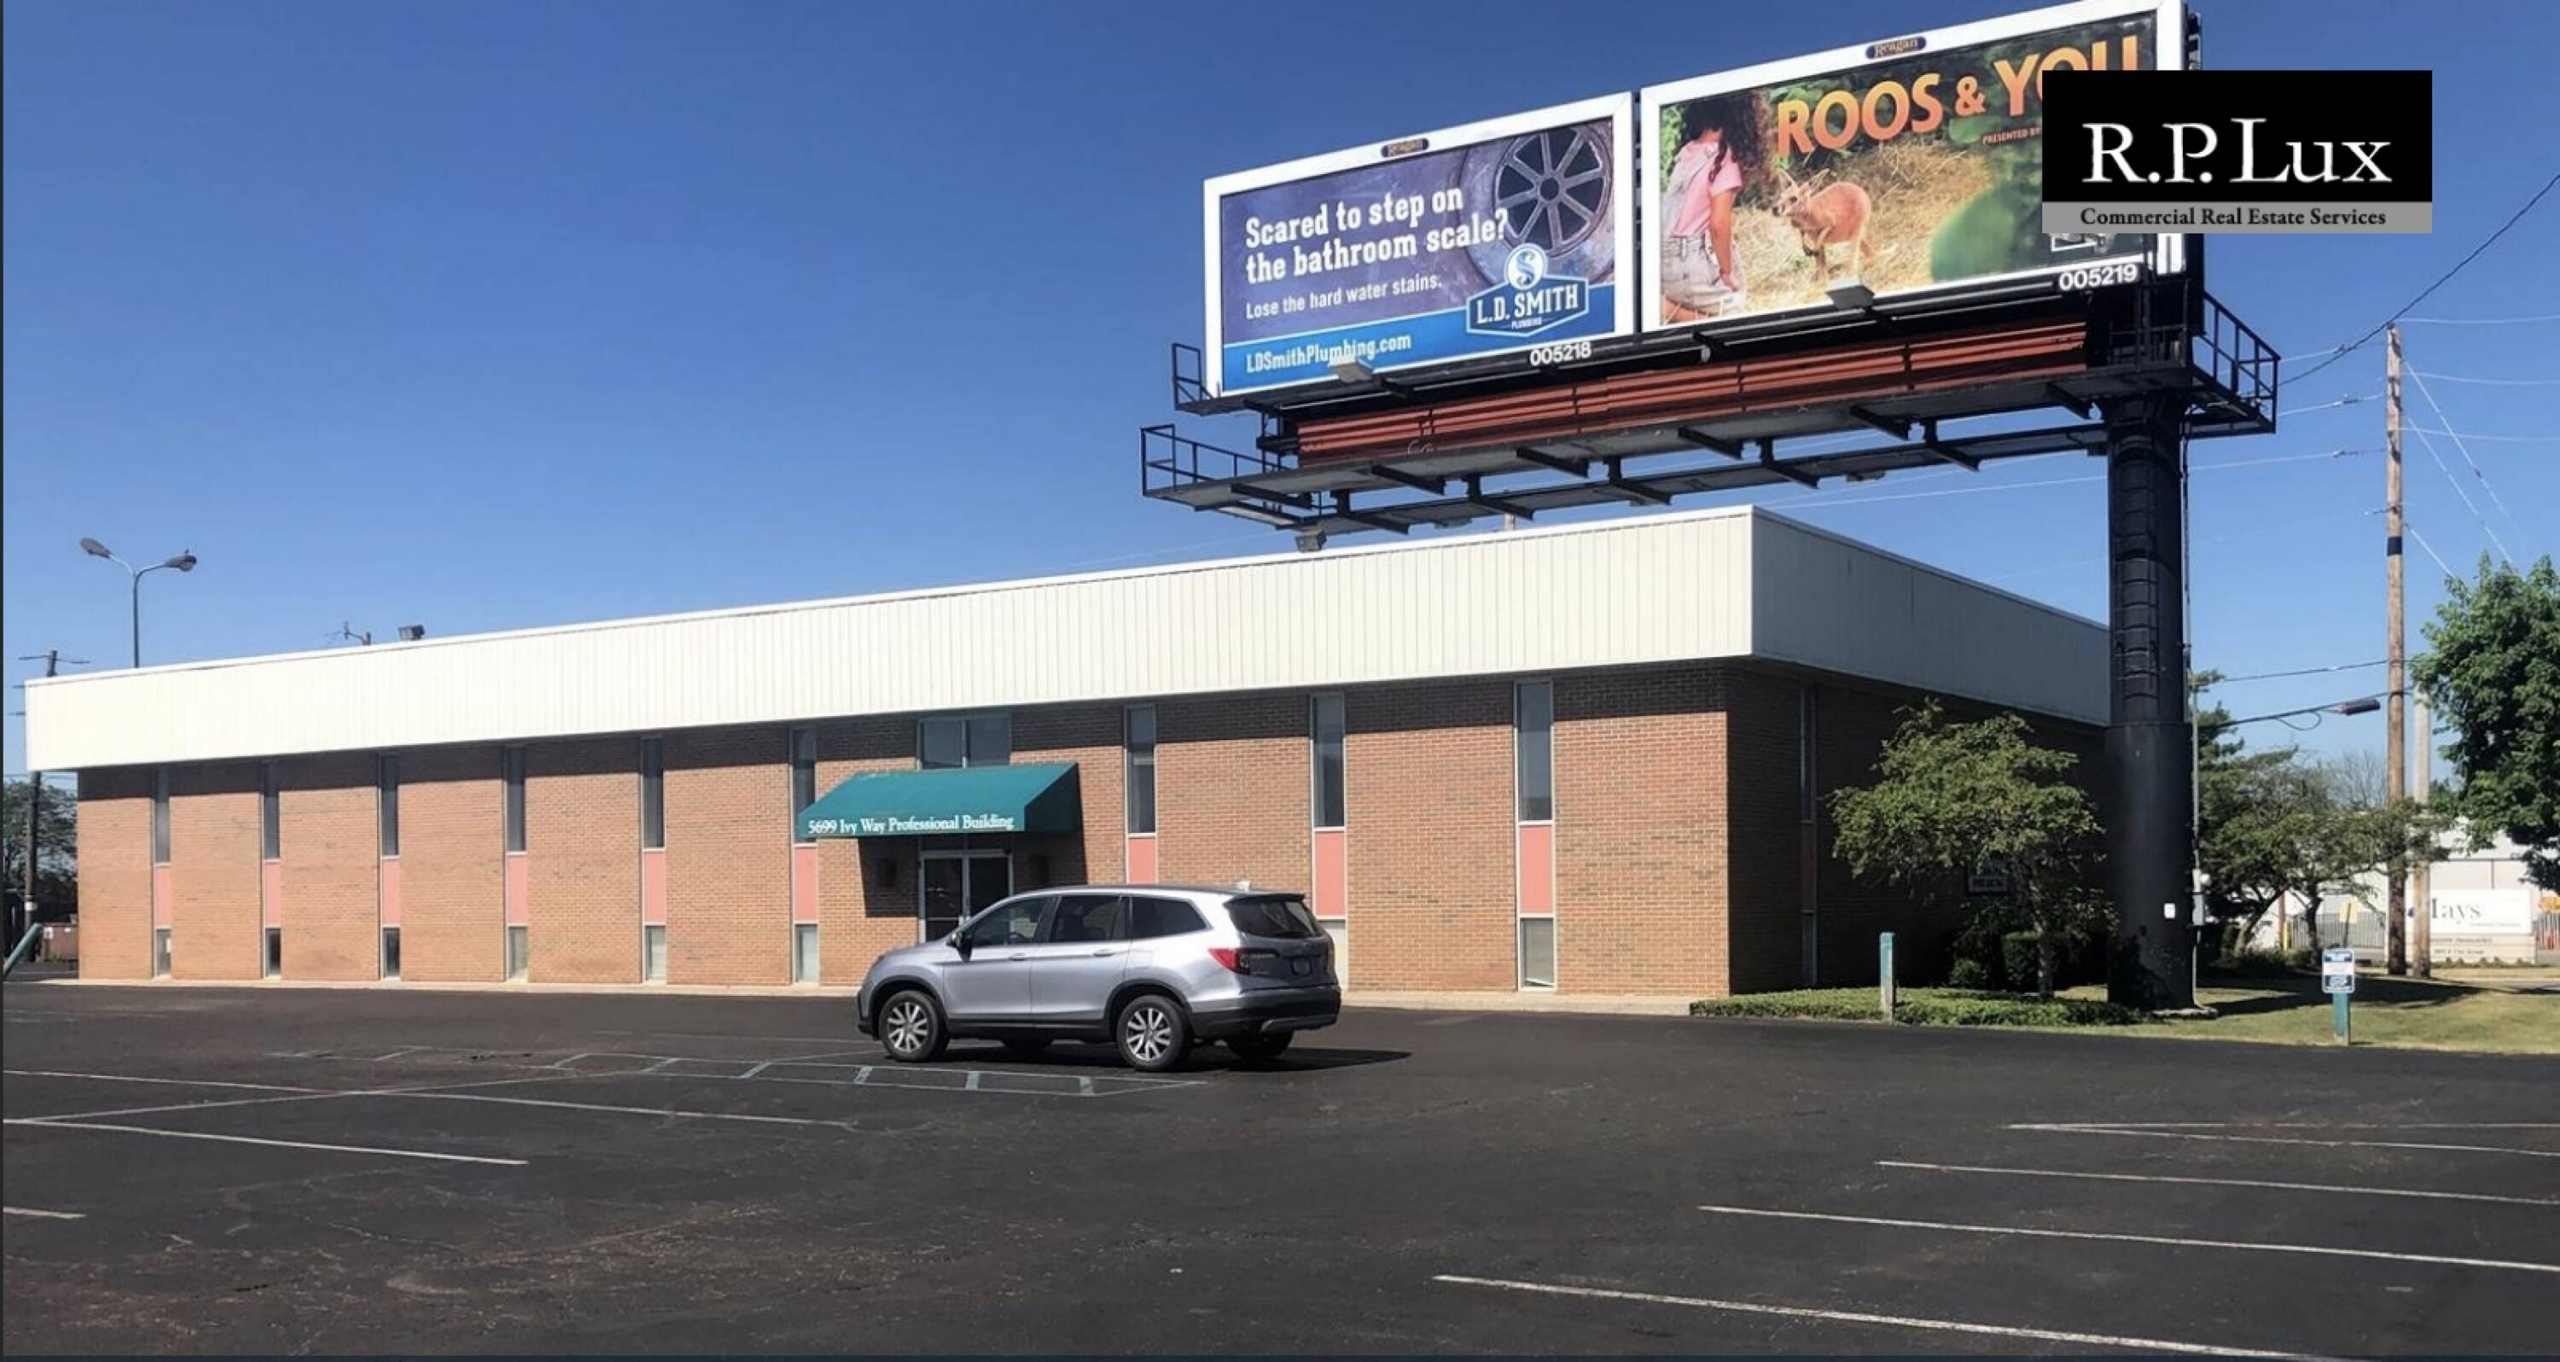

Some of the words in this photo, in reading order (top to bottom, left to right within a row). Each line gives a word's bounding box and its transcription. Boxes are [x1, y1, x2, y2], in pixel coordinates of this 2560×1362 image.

[1778, 73, 1943, 156] ROOS
[1956, 76, 1986, 116] &
[1983, 129, 2029, 145] PRESENTED
[1246, 204, 1328, 248] Scared
[1336, 200, 1361, 231] to
[1368, 192, 1425, 228] step
[1432, 188, 1463, 213] on
[1246, 252, 1286, 284] the
[1294, 235, 1417, 277] bathroom
[1426, 208, 1509, 252] scale?
[1246, 303, 1278, 319] Lose
[1283, 296, 1305, 314] the
[1310, 291, 1341, 309] hard
[1346, 283, 1387, 302] water
[1392, 274, 1442, 295] stains.
[2059, 264, 2138, 290] 005219
[1477, 297, 1510, 324] L.D.
[1514, 284, 1578, 318] SMITH
[1246, 335, 1412, 374] LDSmithPlumbing.com
[1530, 341, 1592, 366] 005218
[808, 819, 837, 834] 5699
[840, 818, 857, 835] Ivy
[860, 817, 886, 834] Way
[888, 815, 959, 832] Professional
[962, 813, 1014, 830] Building
